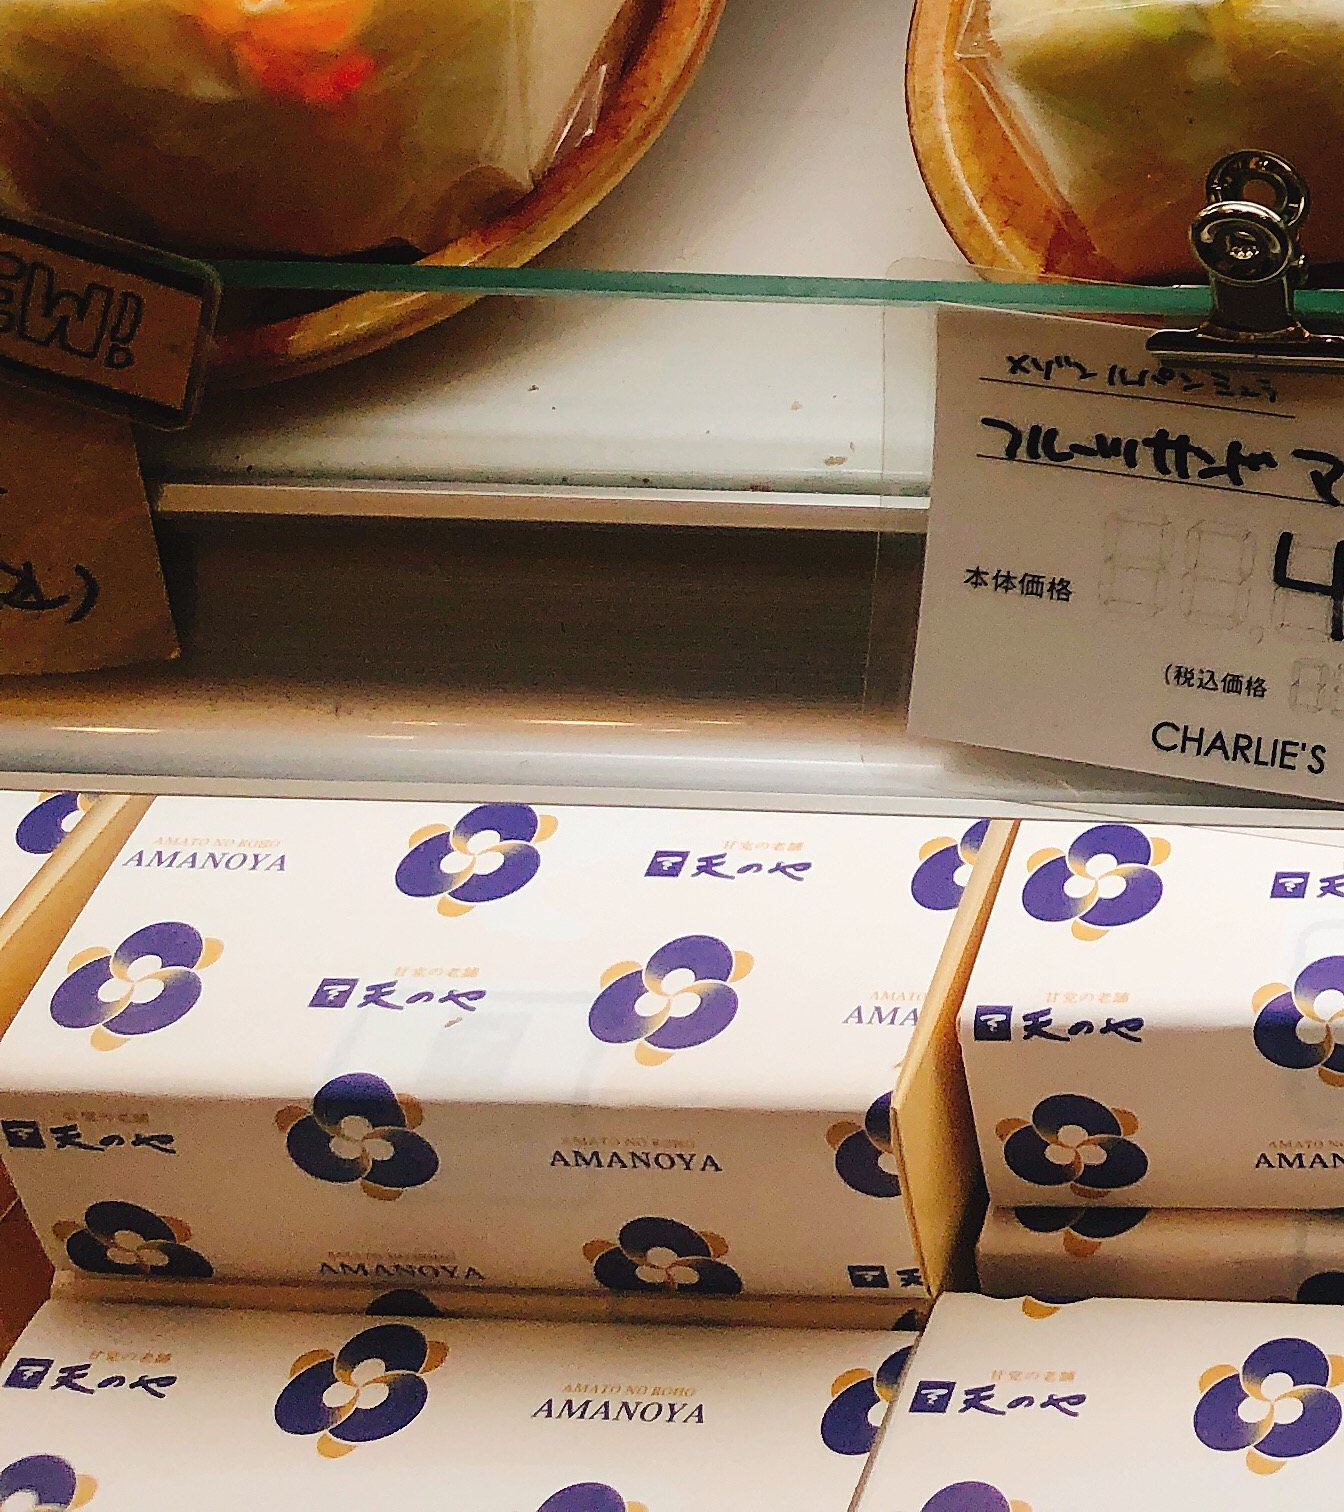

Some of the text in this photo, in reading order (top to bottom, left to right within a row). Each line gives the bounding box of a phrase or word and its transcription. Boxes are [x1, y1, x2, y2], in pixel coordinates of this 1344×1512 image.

[980, 418, 1278, 486] フルーツサンド
[963, 566, 1074, 603] 本体価格
[1162, 661, 1269, 700] (税込価格
[1150, 721, 1329, 775] CHARLIE'S
[121, 848, 289, 872] AMANOYA
[690, 852, 813, 882] 天のや
[356, 979, 487, 1012] 天のや
[1022, 1006, 1145, 1043] 天のや
[48, 1123, 177, 1154] 天のや
[549, 1149, 723, 1172] AMANOYA
[319, 1261, 486, 1281] AMANOYA
[50, 1363, 178, 1399] 天のや
[530, 1397, 706, 1424] AMANOYA
[957, 1383, 1087, 1417] 天のや
